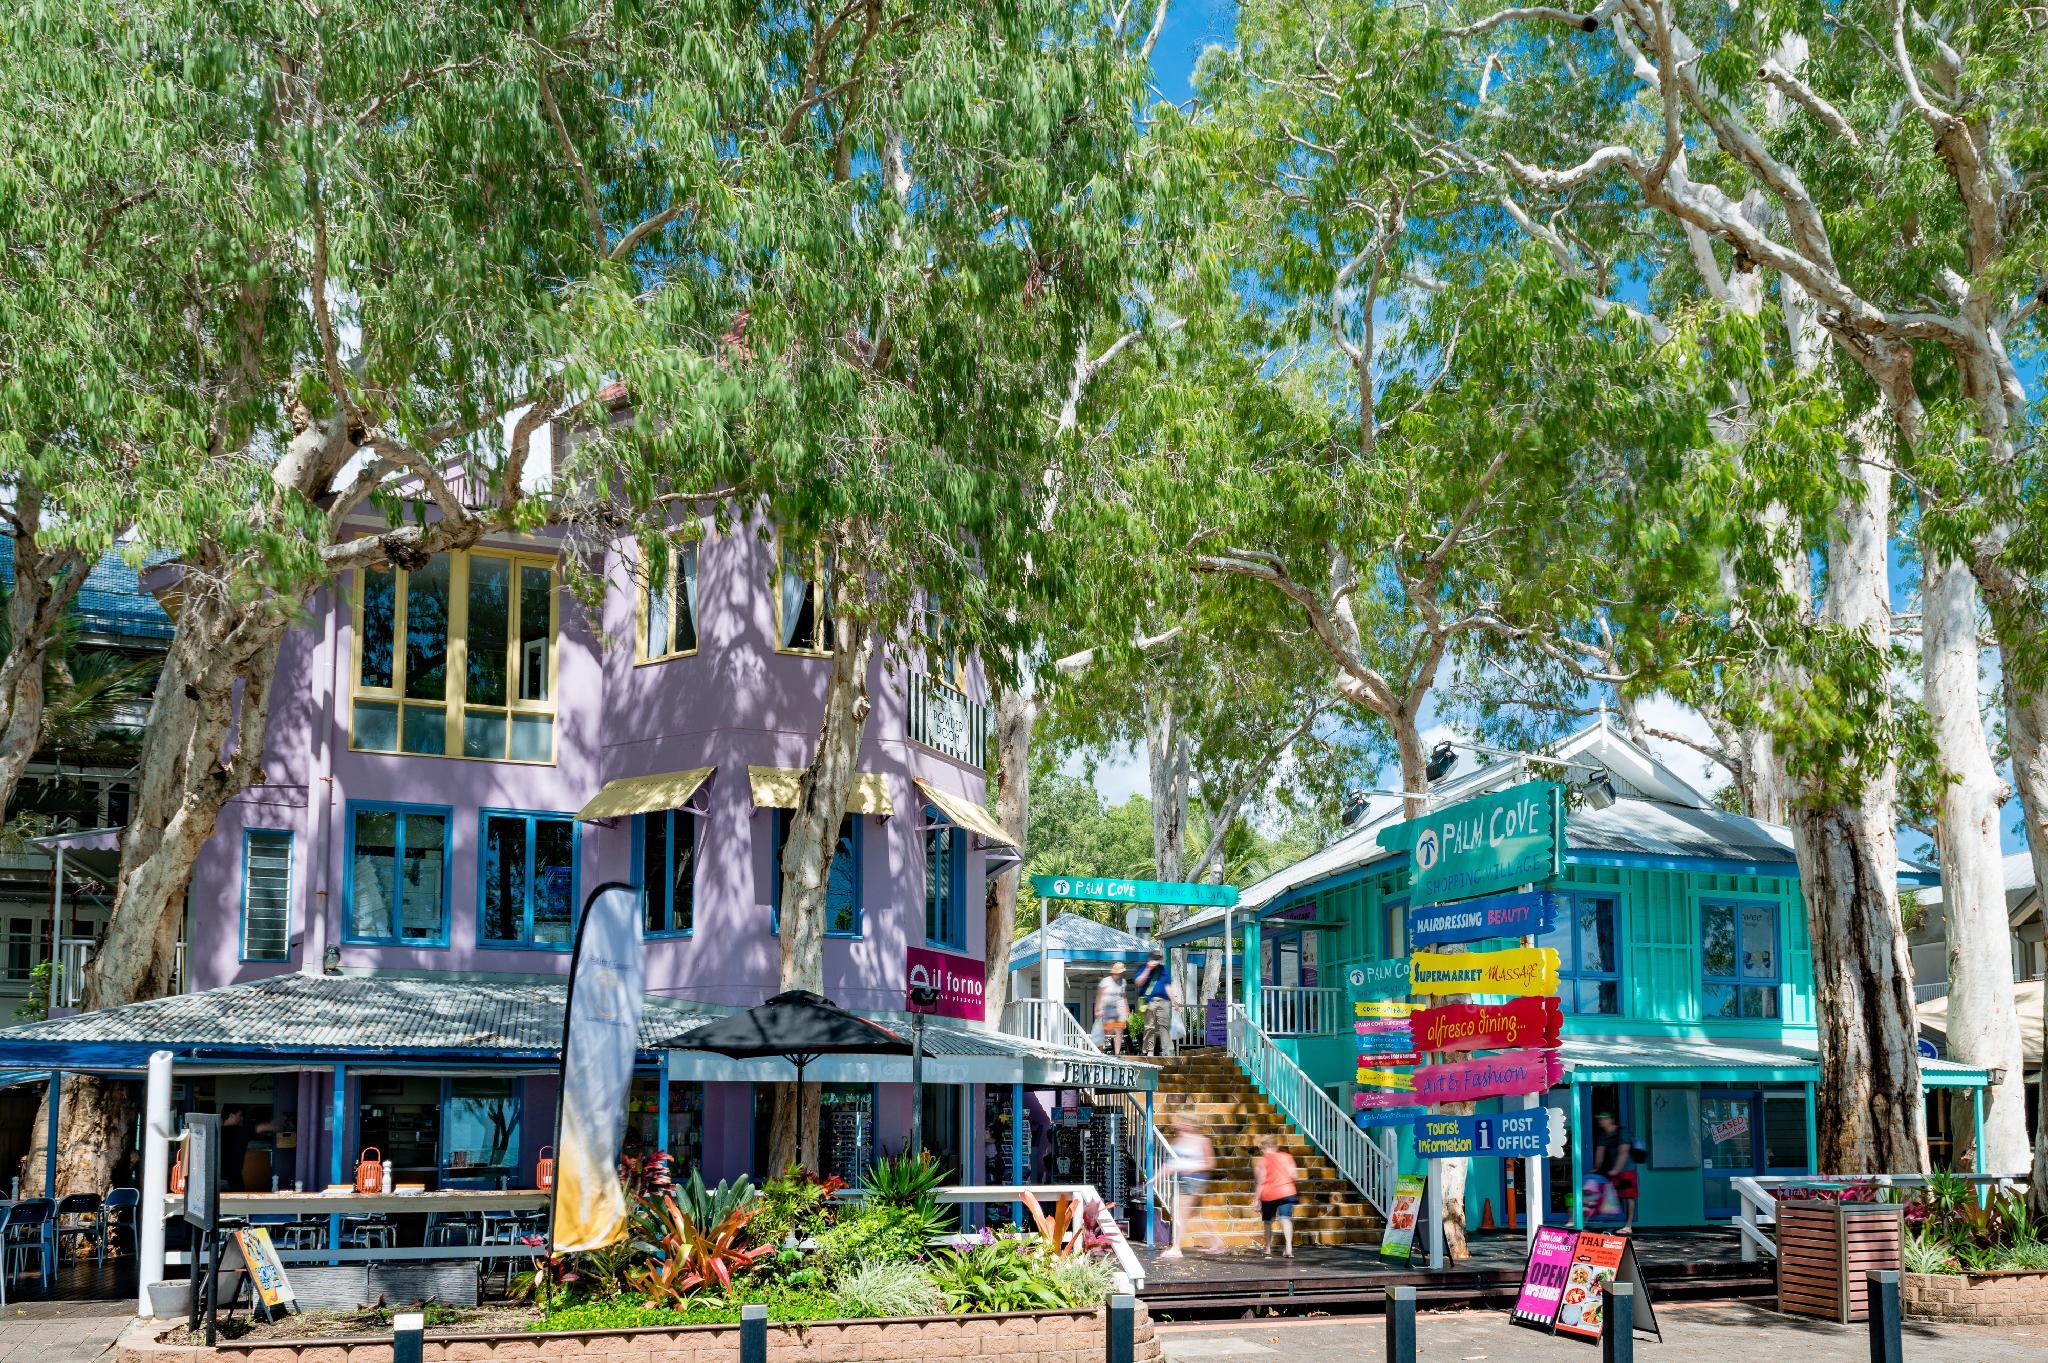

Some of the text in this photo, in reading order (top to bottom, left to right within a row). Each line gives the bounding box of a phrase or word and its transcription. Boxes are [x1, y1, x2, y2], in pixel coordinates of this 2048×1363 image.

[933, 710, 963, 733] POWDER
[937, 724, 960, 745] ROOM
[1442, 798, 1540, 862] PALM COVE
[1426, 853, 1542, 896] SHOPPING VILLAGE
[1075, 881, 1103, 895] PALM
[1107, 882, 1136, 898] COVE
[1417, 906, 1529, 933] HAIRDRESSING BEAUTY
[933, 969, 983, 995] il forno
[1367, 962, 1411, 983] PALM CO
[1414, 962, 1482, 983] SUPERMARKET
[1428, 1015, 1474, 1047] alfresco
[1063, 1062, 1138, 1087] JEWELLER
[1423, 1076, 1444, 1093] Art
[1447, 1073, 1459, 1091] &
[1464, 1065, 1527, 1091] Fashion
[1426, 1121, 1459, 1135] Tourist
[1502, 1118, 1533, 1132] POST
[1711, 1116, 1744, 1136] LEASED
[1497, 1135, 1540, 1150] OFFICE
[1581, 1235, 1605, 1248] THAI
[1530, 1262, 1567, 1288] OPEN
[1524, 1284, 1561, 1302] UPSTAIRS
